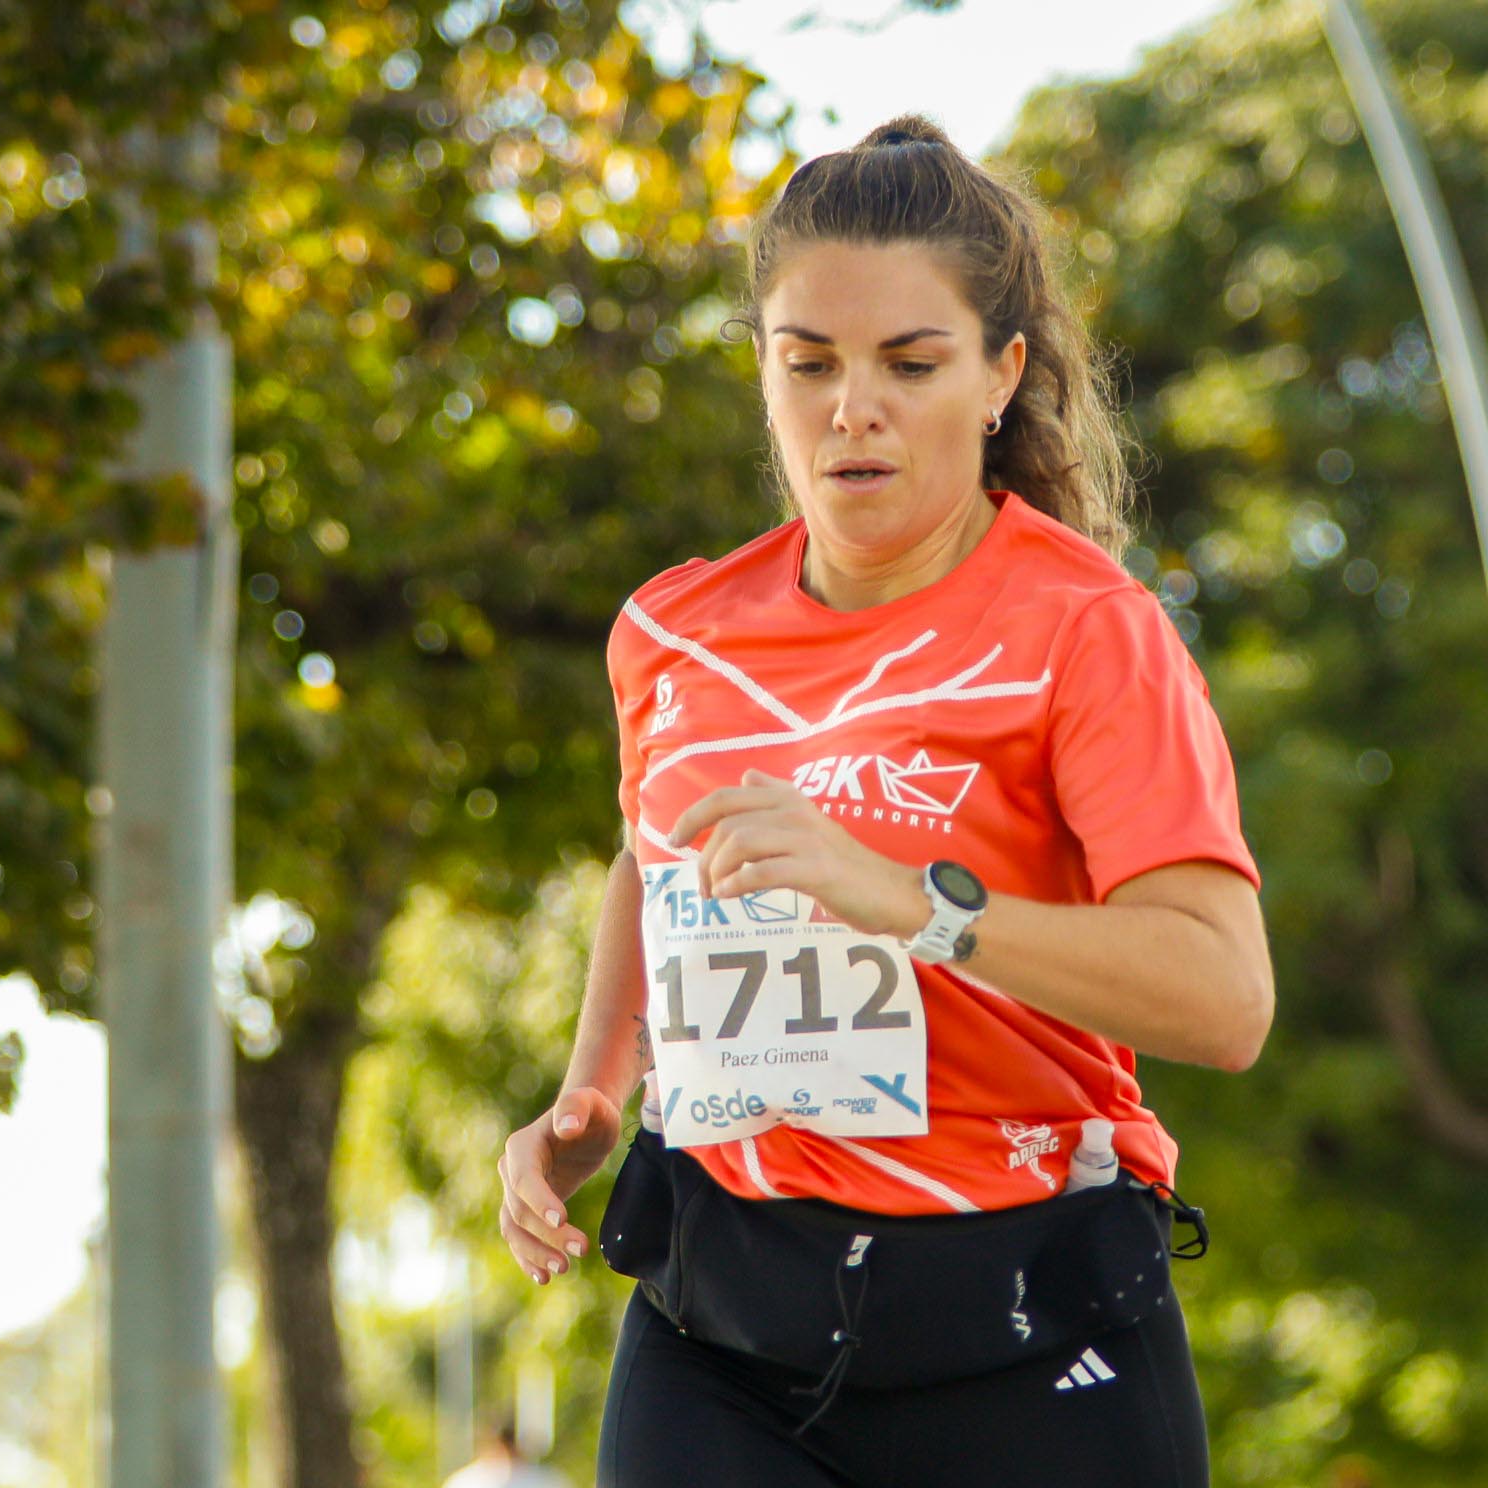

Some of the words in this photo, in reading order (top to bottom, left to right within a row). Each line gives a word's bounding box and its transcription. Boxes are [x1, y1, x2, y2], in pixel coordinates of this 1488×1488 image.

[792, 755, 874, 801] 15K
[822, 803, 864, 818] RTO
[873, 808, 953, 834] NORTE
[664, 888, 730, 929] 15K
[694, 931, 721, 941] NORTE
[755, 927, 795, 937] ROSARIO
[655, 943, 912, 1043] 1712
[720, 1050, 760, 1068] Paez
[764, 1047, 829, 1065] Gimena
[690, 1088, 768, 1126] osde
[1009, 1136, 1060, 1170] ARDEC
